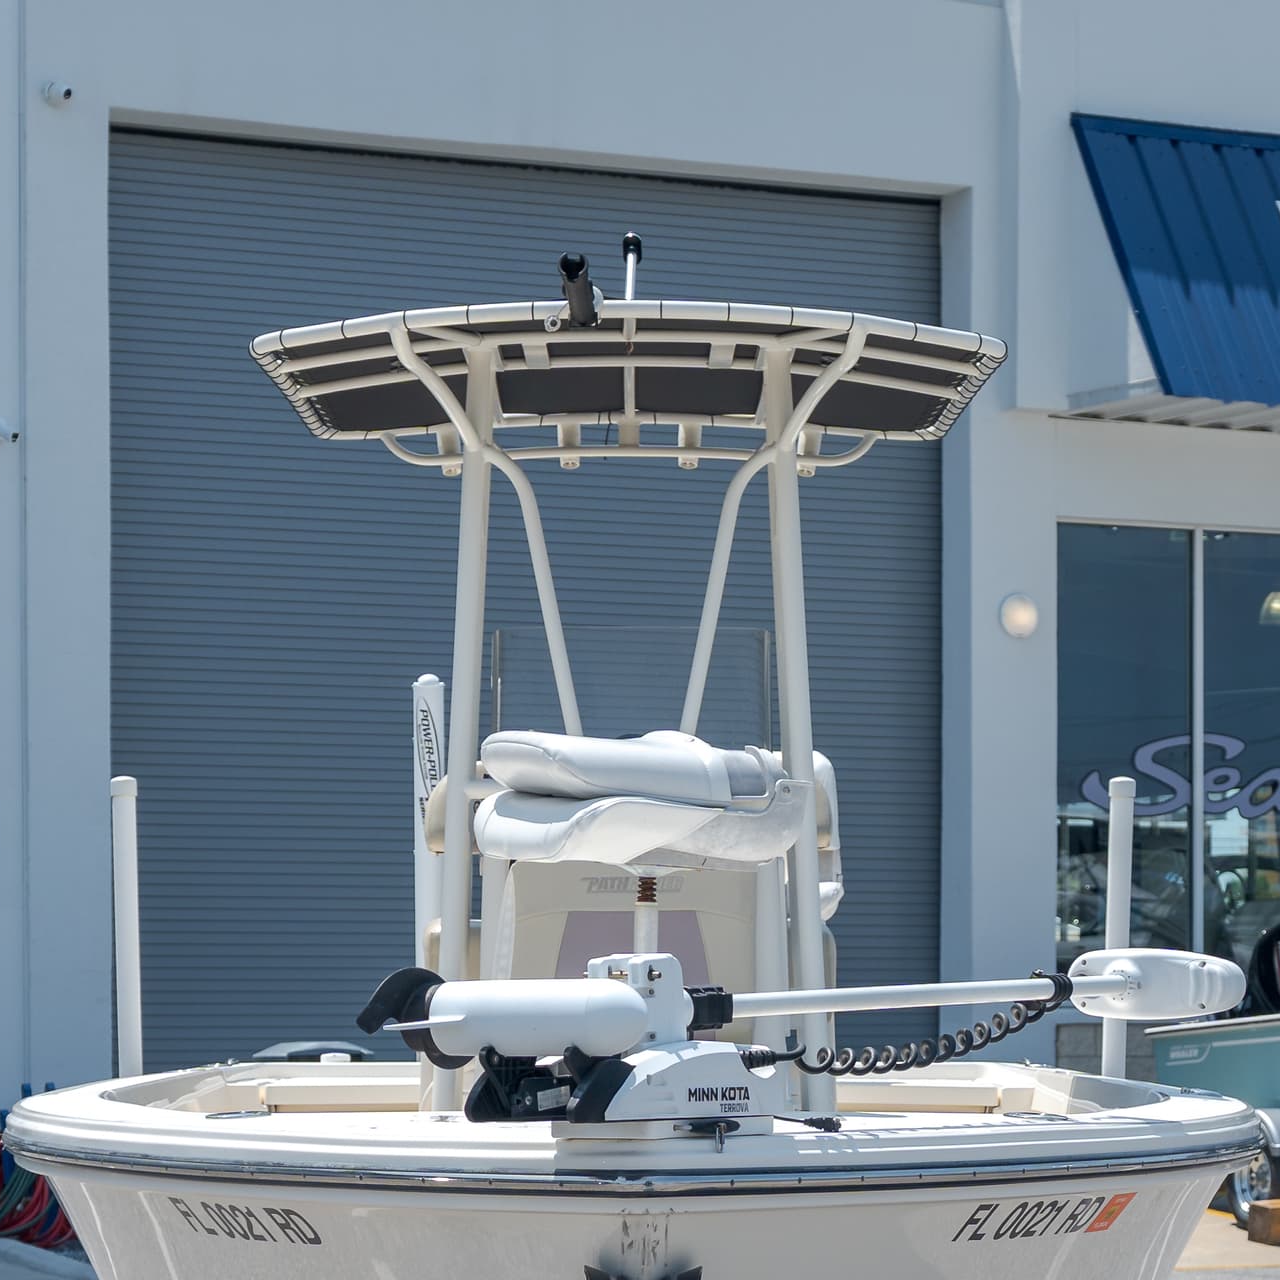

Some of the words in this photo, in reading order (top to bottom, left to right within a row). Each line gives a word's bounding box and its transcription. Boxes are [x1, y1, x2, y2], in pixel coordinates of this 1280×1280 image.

[688, 1087, 718, 1102] MINN
[721, 1086, 750, 1102] KOTA
[720, 1103, 749, 1113] TERROVA
[168, 1197, 218, 1236] FL
[200, 1202, 277, 1243] 0021
[262, 1208, 322, 1245] RD
[952, 1203, 1000, 1242] FL
[993, 1200, 1070, 1241] 0021
[1054, 1197, 1105, 1235] RD
